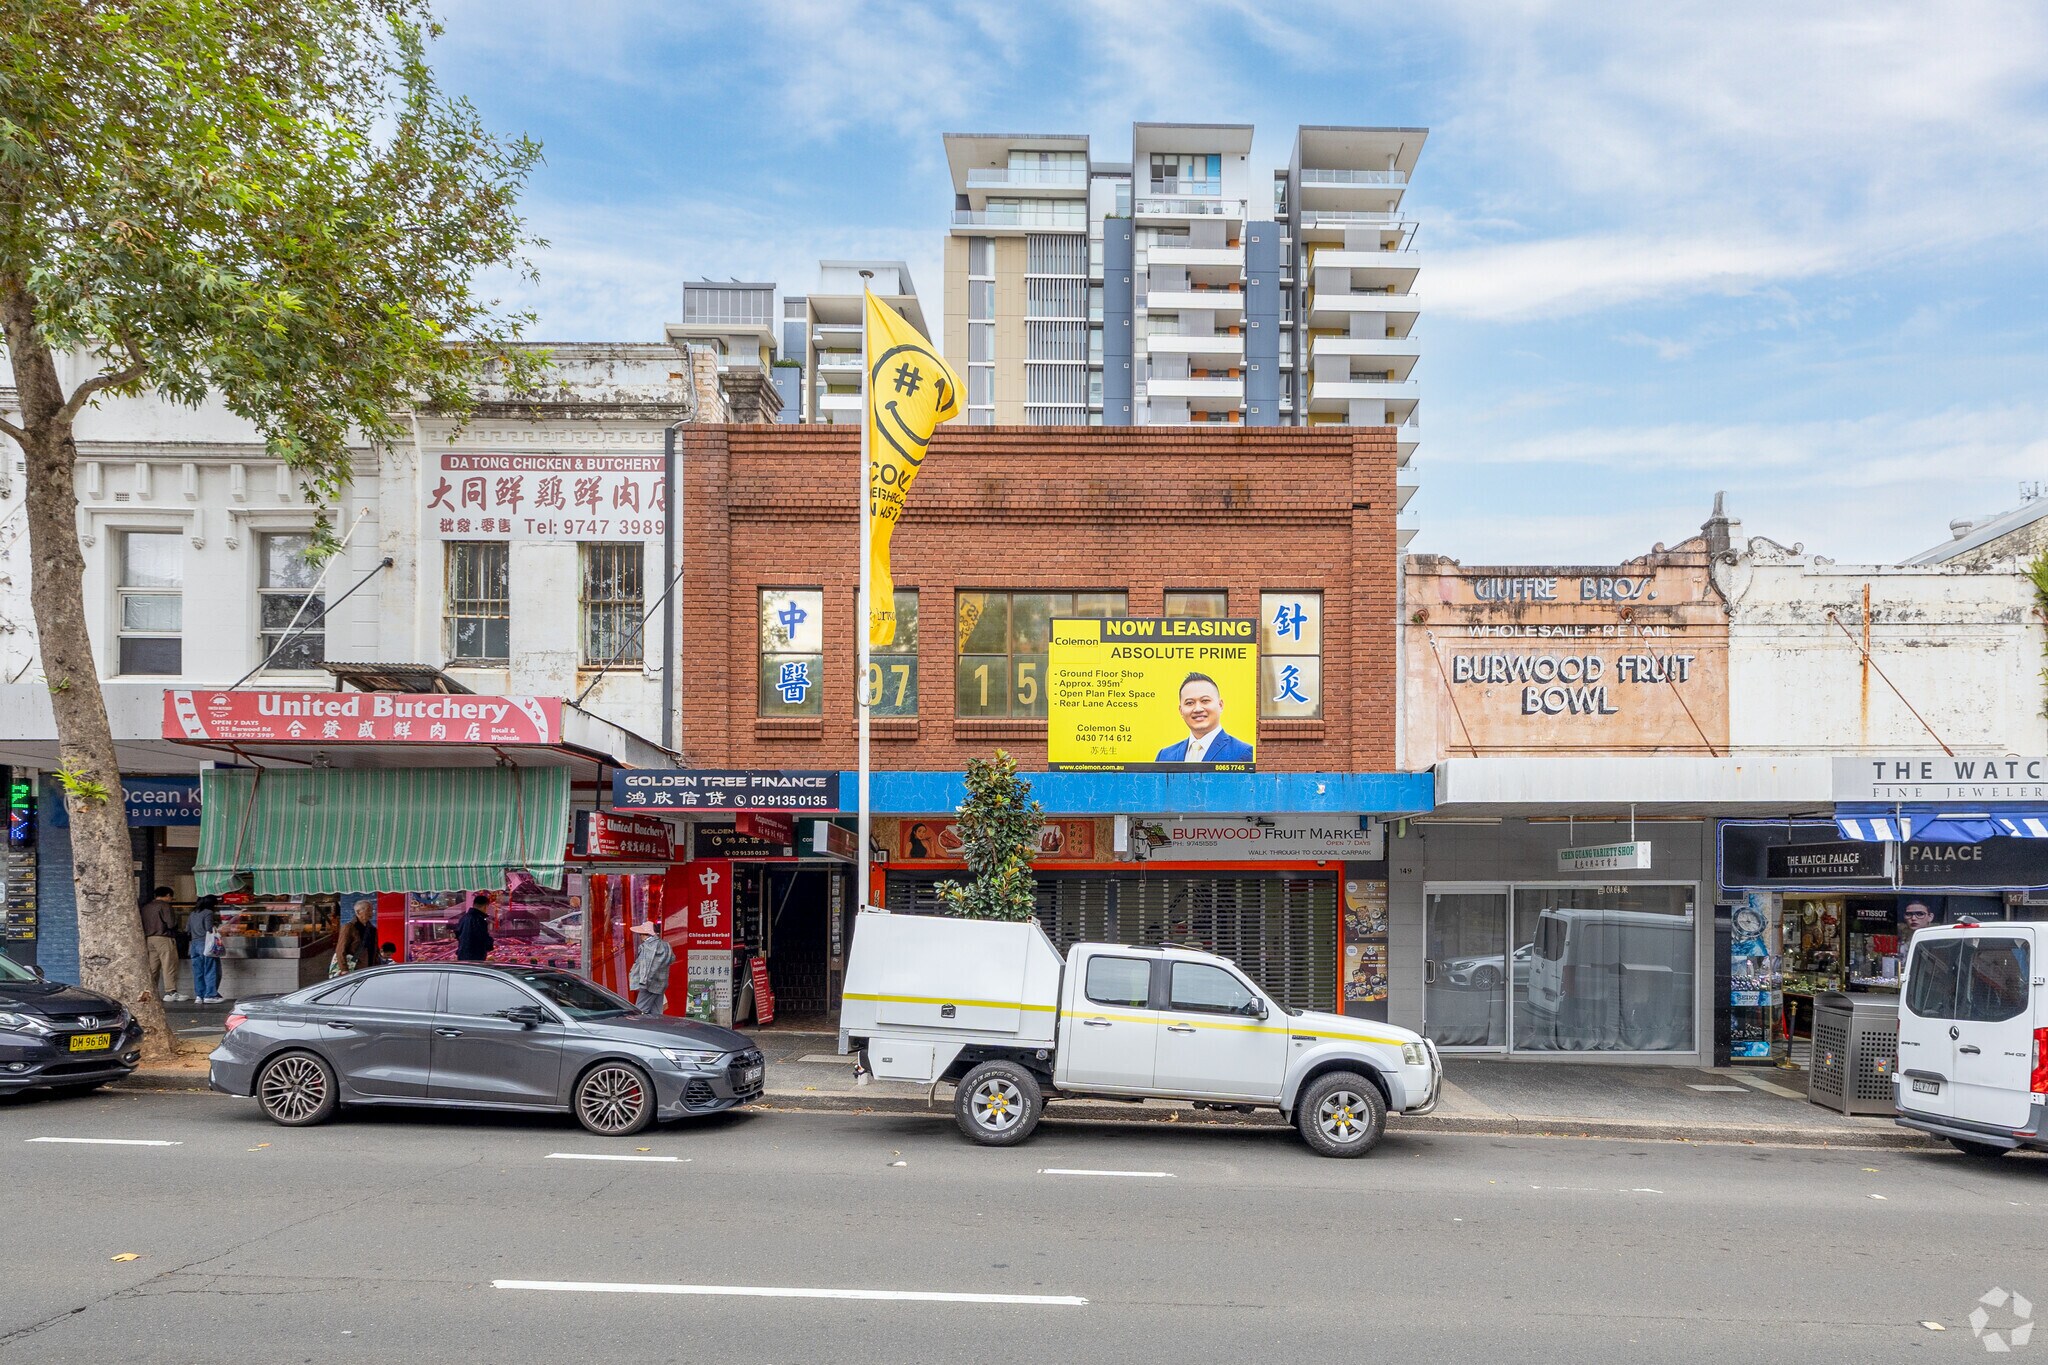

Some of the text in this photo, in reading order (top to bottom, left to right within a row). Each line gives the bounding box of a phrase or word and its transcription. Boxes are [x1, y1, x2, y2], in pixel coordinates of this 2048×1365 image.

[450, 457, 661, 470] DA TONG CHICKEN & BUTCHERY
[524, 518, 558, 535] Tel:
[564, 519, 610, 535] 9747
[619, 519, 665, 535] 3989
[1474, 577, 1659, 600] GIUFFRE BROS.
[1106, 620, 1252, 636] NOW LEASING
[1469, 625, 1585, 637] WHOLESALE
[1602, 625, 1671, 637] RETAIL
[1055, 637, 1099, 646] Colemon
[777, 600, 812, 703] 中醫
[1111, 647, 1247, 660] ABSOLUTE PRIME
[1272, 602, 1310, 704] 針灸
[1059, 669, 1144, 680] Ground Floor Shop
[1453, 654, 1696, 683] BURWOOD FRUIT
[869, 662, 910, 707] 97
[1059, 679, 1094, 689] Approx.
[1059, 690, 1156, 699] Open Plan Flex Space
[1521, 686, 1619, 715] BOWL
[258, 694, 510, 724] United Butchery
[1059, 699, 1139, 708] Rear Lane Access
[1077, 724, 1131, 732] Colemon Su
[1076, 734, 1132, 742] 0430 714 612
[1090, 746, 1118, 755] 苏先生
[1873, 761, 2041, 780] THE WATC
[625, 776, 827, 788] GOLDEN TREE FINANCE
[626, 791, 727, 806] 鸿欣信贷
[1873, 787, 2048, 799] FINE JEWELER
[751, 795, 827, 806] 02 9135 0135
[607, 818, 666, 839] United Butchery
[1173, 827, 1261, 840] BURWOOD
[1560, 845, 1635, 860] CHEN GUANG VARIETY SHOP
[1787, 852, 1860, 865] THE WATCH PALACE
[1909, 846, 1983, 861] PALACE
[697, 867, 722, 928] 中醫
[2008, 893, 2023, 903] 147
[687, 966, 702, 975] CLC
[72, 1035, 109, 1048] DM 96 BN
